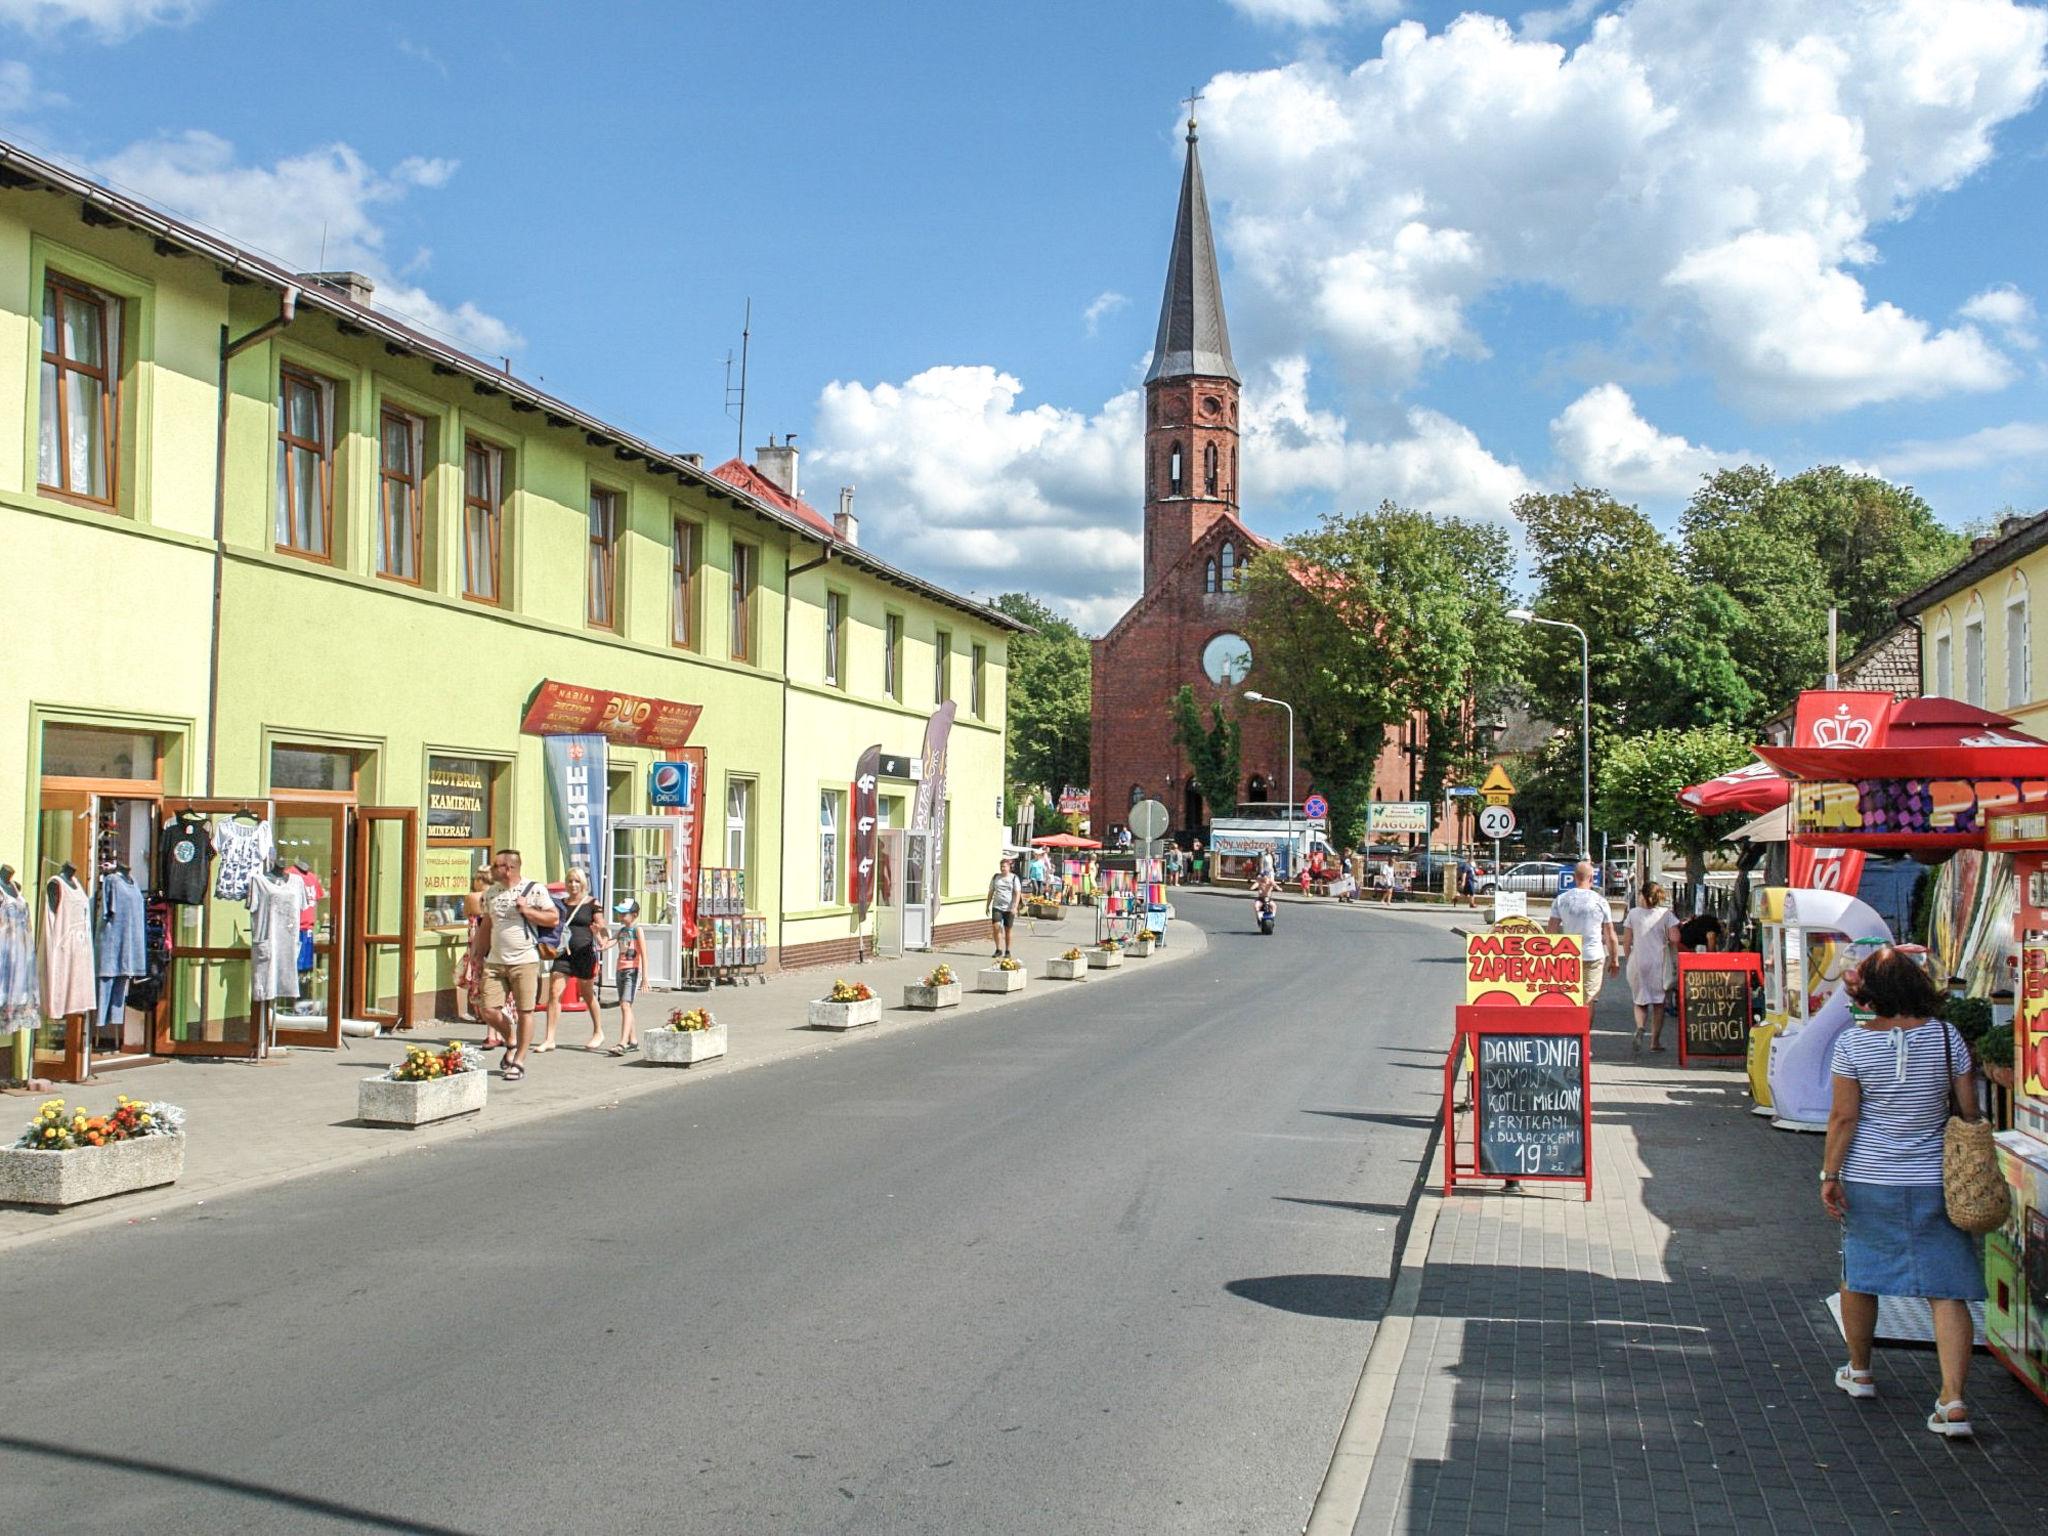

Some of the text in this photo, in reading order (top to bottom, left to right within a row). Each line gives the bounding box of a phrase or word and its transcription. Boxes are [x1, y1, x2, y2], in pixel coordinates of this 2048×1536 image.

[602, 695, 651, 724] DUO
[430, 794, 482, 812] KAMIENIA
[1373, 820, 1426, 830] JAGODA
[1486, 813, 1510, 829] 20
[427, 825, 471, 839] MINERAŁY
[1468, 936, 1581, 956] MEGA
[1469, 957, 1580, 982] ZAPIEKANKI
[1687, 971, 1731, 986] OBIADY
[1690, 985, 1742, 1000] DOMOWE
[1696, 1001, 1736, 1016] ZUPY
[1484, 1037, 1579, 1067] DANIE DNIA
[1486, 1067, 1552, 1089] DOMOWY
[1498, 1115, 1567, 1130] FRYTKAMI
[1515, 1144, 1541, 1174] 19
